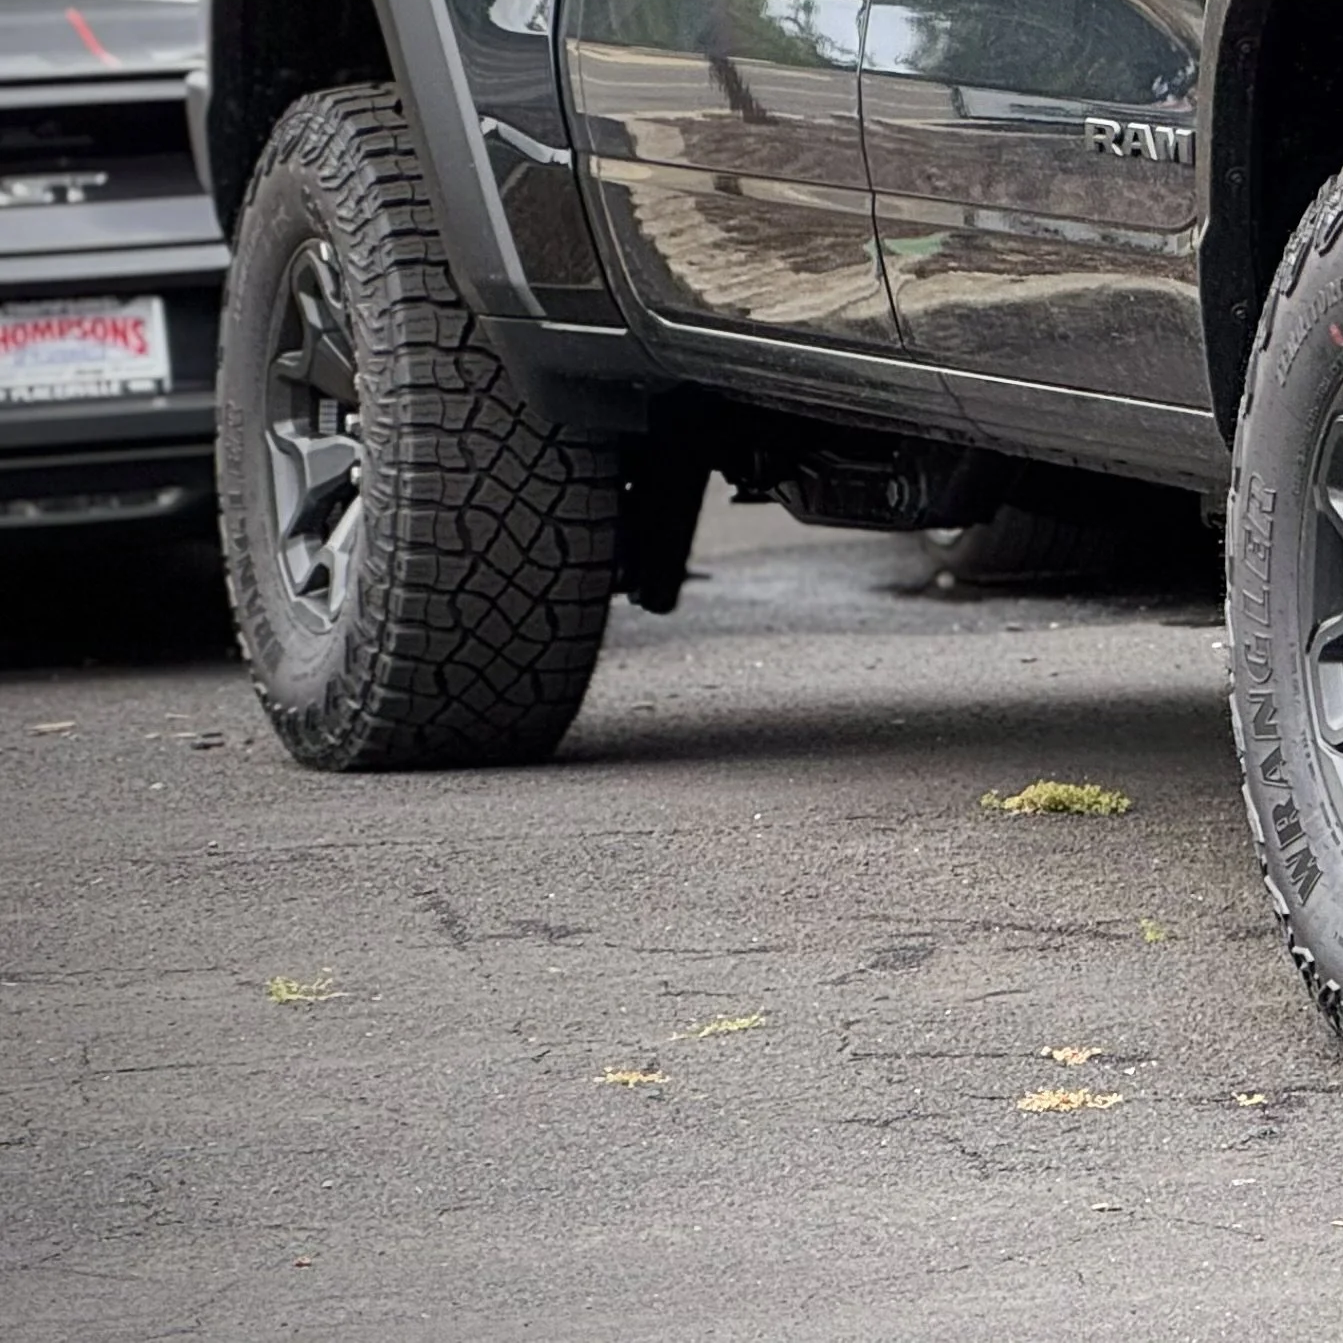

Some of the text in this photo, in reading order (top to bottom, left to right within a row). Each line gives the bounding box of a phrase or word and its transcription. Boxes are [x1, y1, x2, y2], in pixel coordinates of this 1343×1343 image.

[1084, 116, 1197, 166] RAM
[0, 317, 149, 356] HOMPSONS
[1241, 471, 1324, 907] WRANGLER
